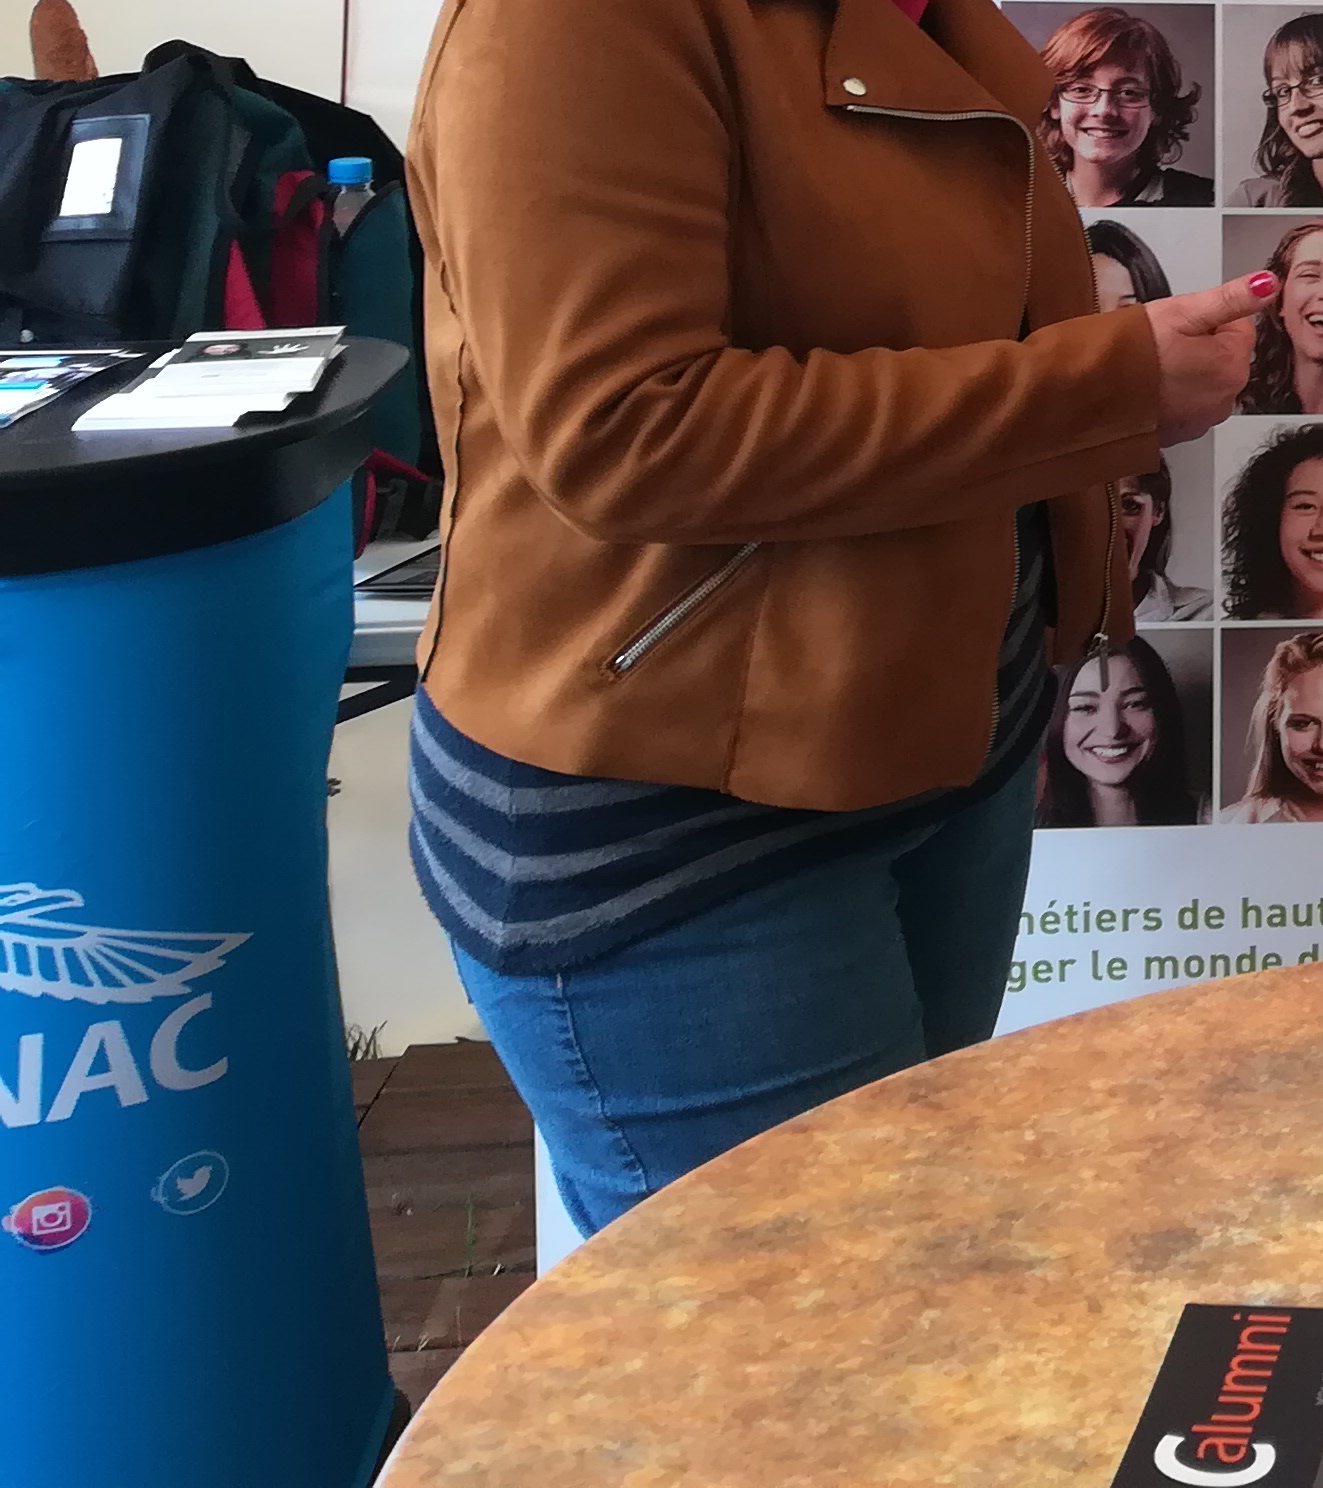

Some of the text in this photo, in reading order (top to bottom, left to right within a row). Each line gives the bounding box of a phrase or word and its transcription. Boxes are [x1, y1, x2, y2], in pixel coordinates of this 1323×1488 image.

[1177, 899, 1226, 931] de
[1091, 950, 1129, 981] le
[1144, 946, 1283, 980] monde
[1191, 1312, 1292, 1464] alumni
